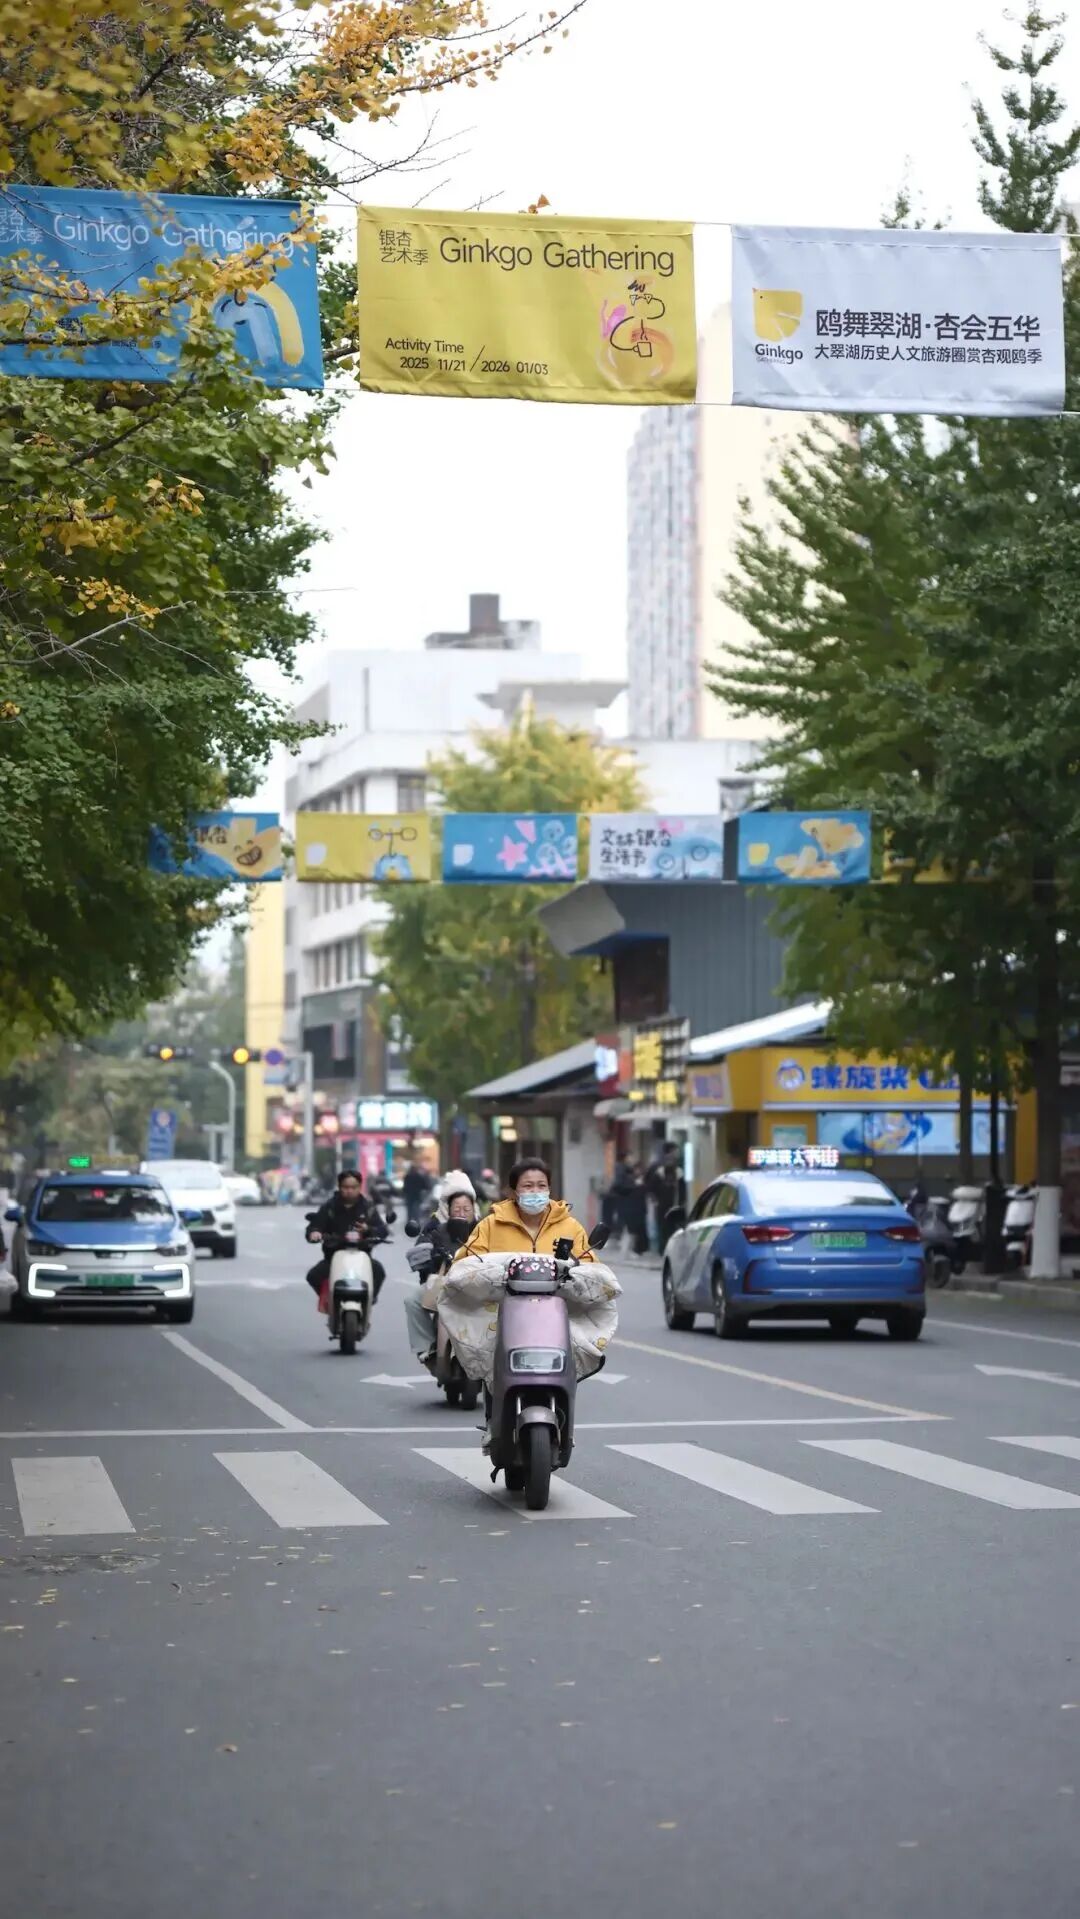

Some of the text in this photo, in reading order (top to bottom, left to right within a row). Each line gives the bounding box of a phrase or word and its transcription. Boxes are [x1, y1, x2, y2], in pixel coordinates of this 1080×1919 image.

[54, 214, 150, 251] Ginkgo
[379, 229, 412, 247] 银杏
[380, 246, 429, 266] 艺术季
[440, 236, 675, 277] Ginkgo Gathering
[816, 308, 1041, 342] 鸥舞翠湖·杏会五华
[385, 337, 465, 354] Activity Time
[755, 343, 804, 365] Ginkgo
[815, 343, 1043, 365] 大翠湖历史人文旅游圈赏杏观鸥季
[400, 356, 429, 369] 2025
[437, 359, 466, 371] 11/21
[481, 360, 511, 373] 2026
[516, 361, 549, 375] 01/03
